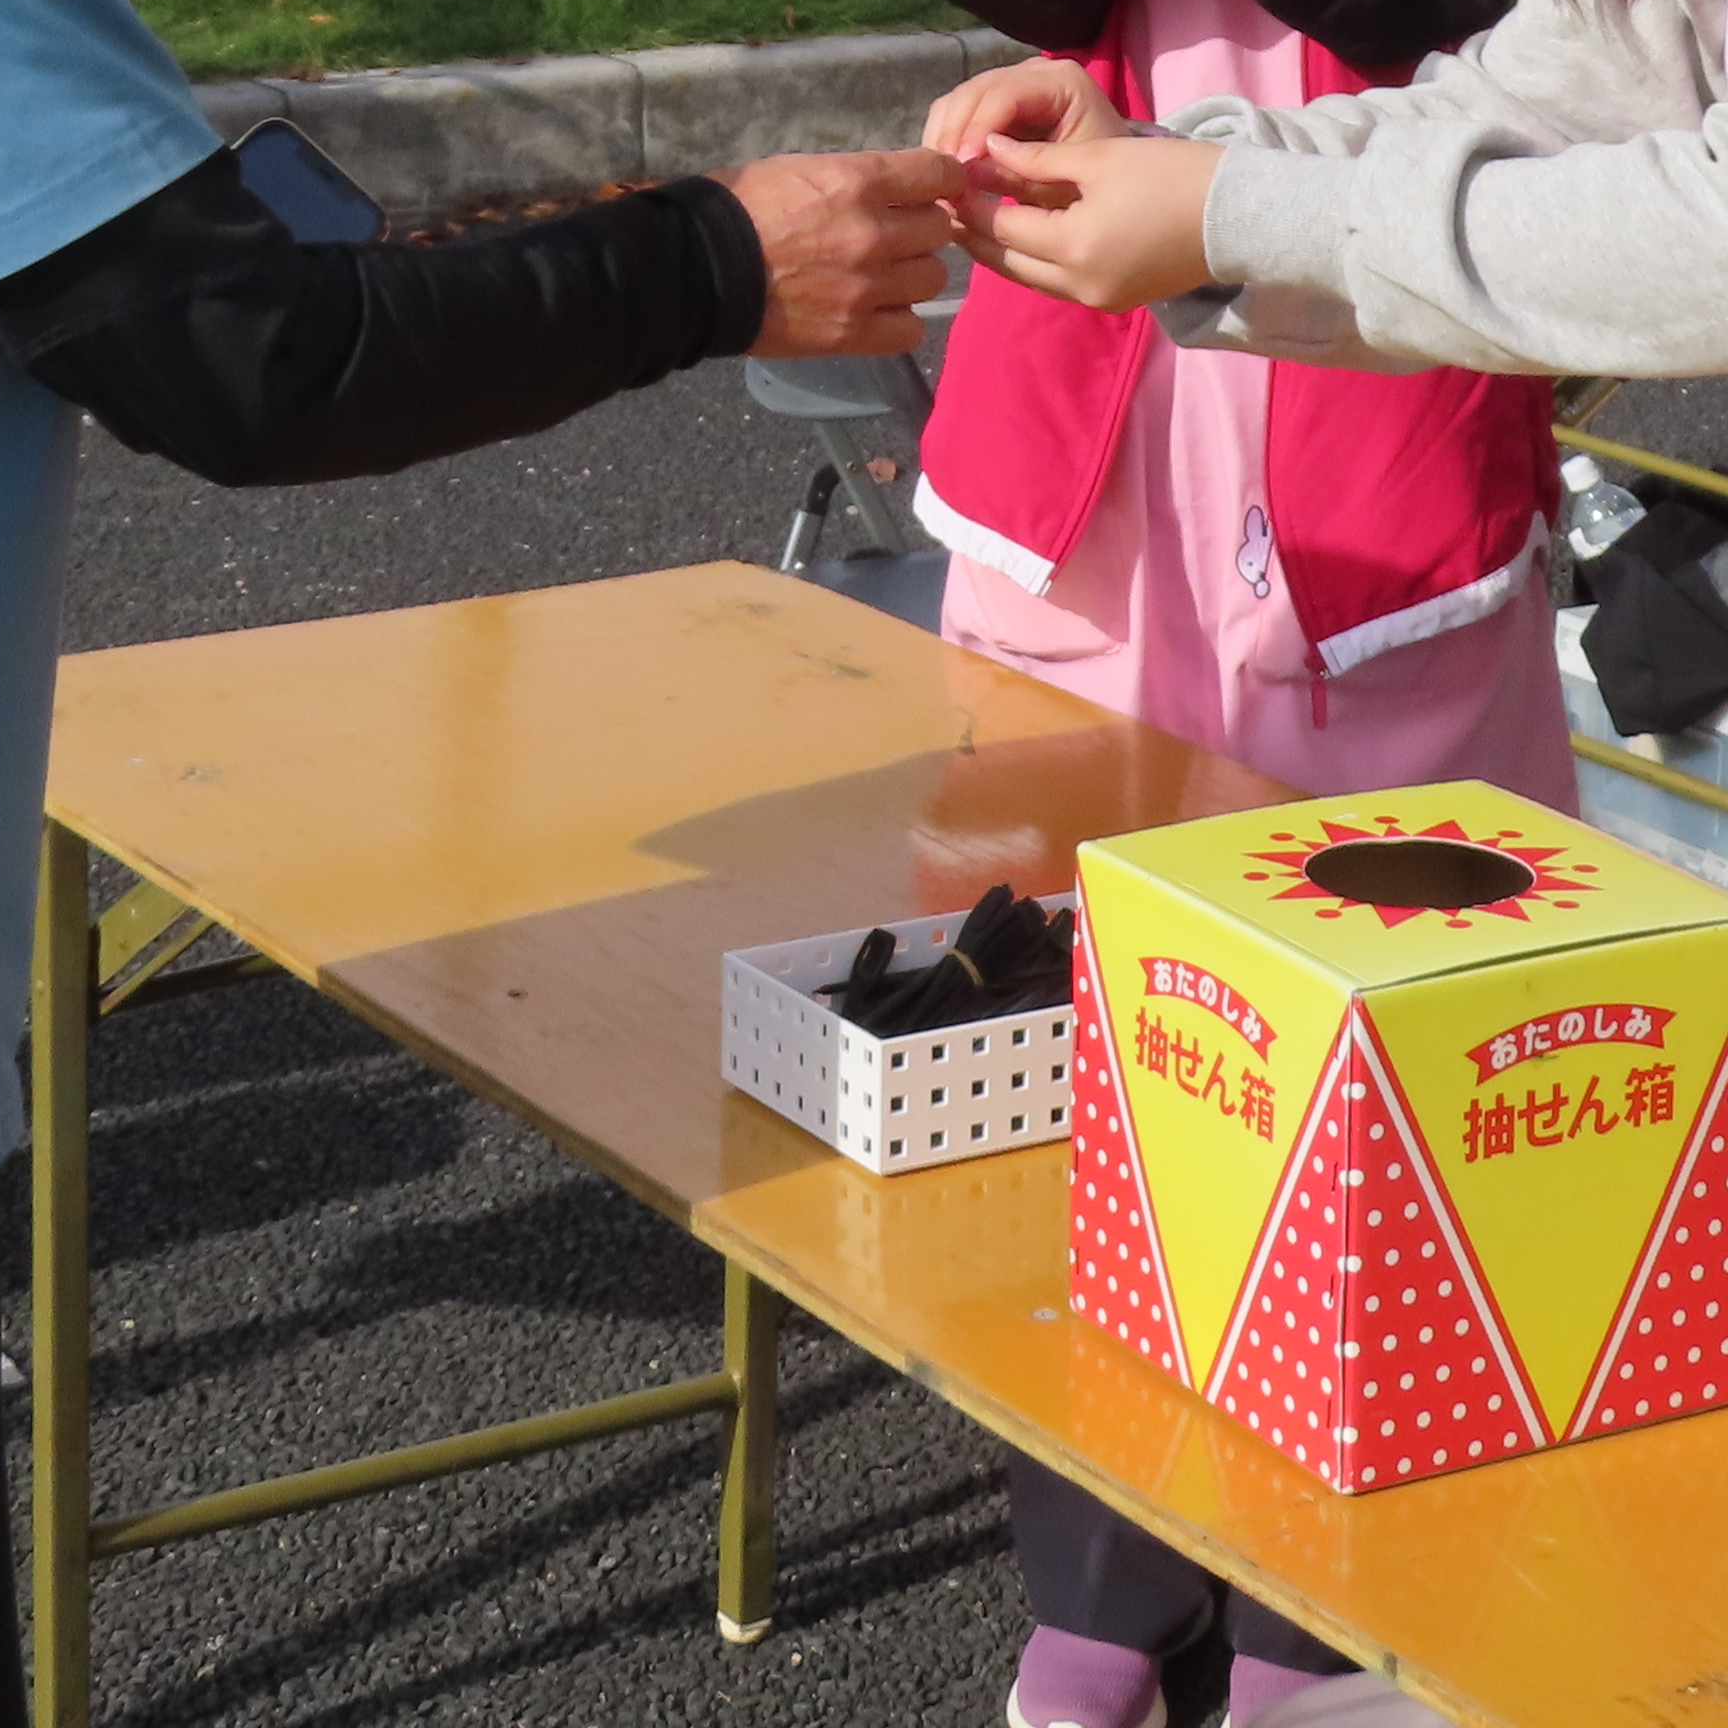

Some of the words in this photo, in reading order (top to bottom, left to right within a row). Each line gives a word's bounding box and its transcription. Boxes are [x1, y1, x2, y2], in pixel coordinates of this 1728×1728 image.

[1153, 960, 1262, 1043] おたのしみ
[1488, 1007, 1652, 1070] おたのしみ
[1135, 1005, 1276, 1144] 抽せん箱
[1462, 1063, 1676, 1164] 抽せん箱
